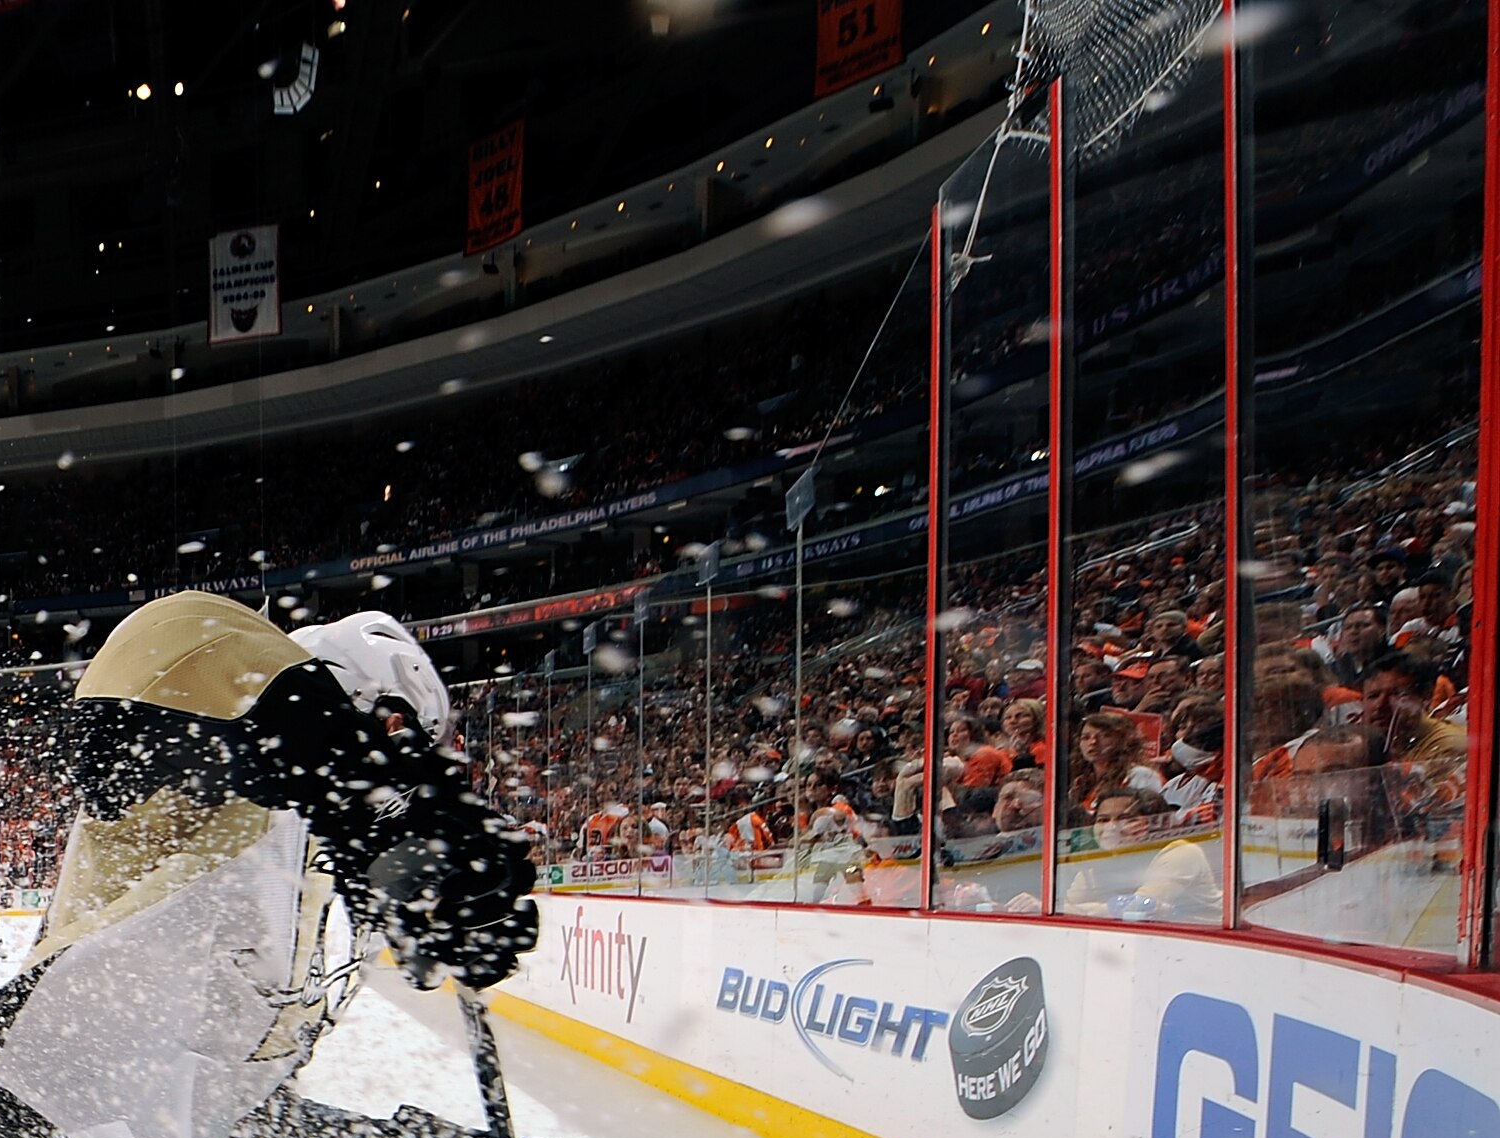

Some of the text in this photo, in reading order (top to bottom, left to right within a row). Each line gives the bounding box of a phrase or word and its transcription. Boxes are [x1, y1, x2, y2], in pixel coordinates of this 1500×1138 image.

[349, 492, 657, 571] OFFICIAL AIRLINE OF THE PHILADELPHIA FLYERS
[560, 904, 647, 1024] xfinity
[969, 993, 1009, 1022] NHL
[715, 966, 950, 1063] BUD LIGHT
[957, 1007, 1048, 1101] HERE WE GO
